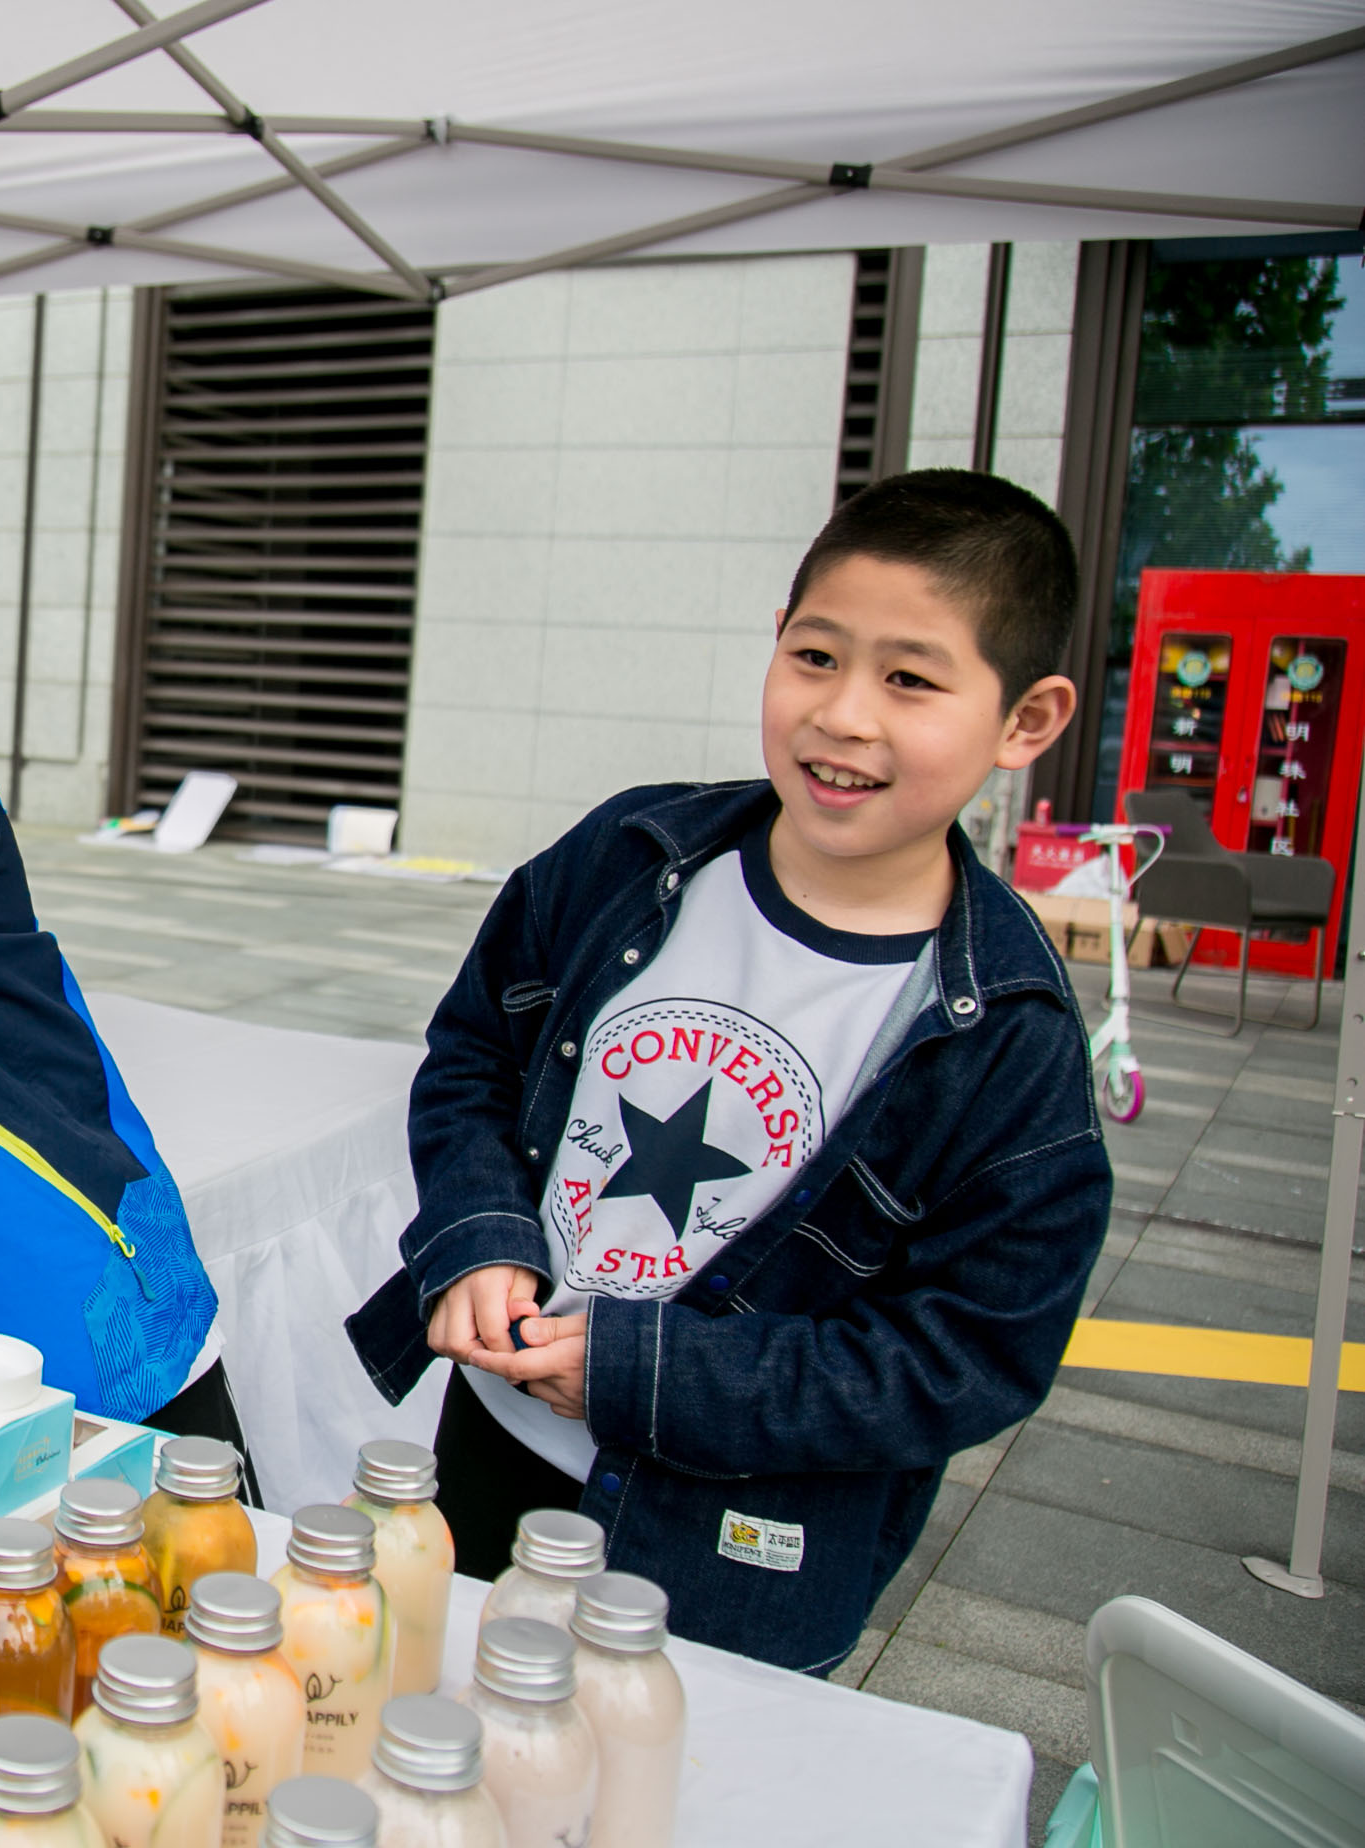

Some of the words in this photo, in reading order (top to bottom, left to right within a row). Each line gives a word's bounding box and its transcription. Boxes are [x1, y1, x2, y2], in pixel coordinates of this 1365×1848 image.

[601, 1027, 799, 1169] CONVERSE
[566, 1118, 623, 1169] Chuck
[306, 1709, 359, 1727] APPILY
